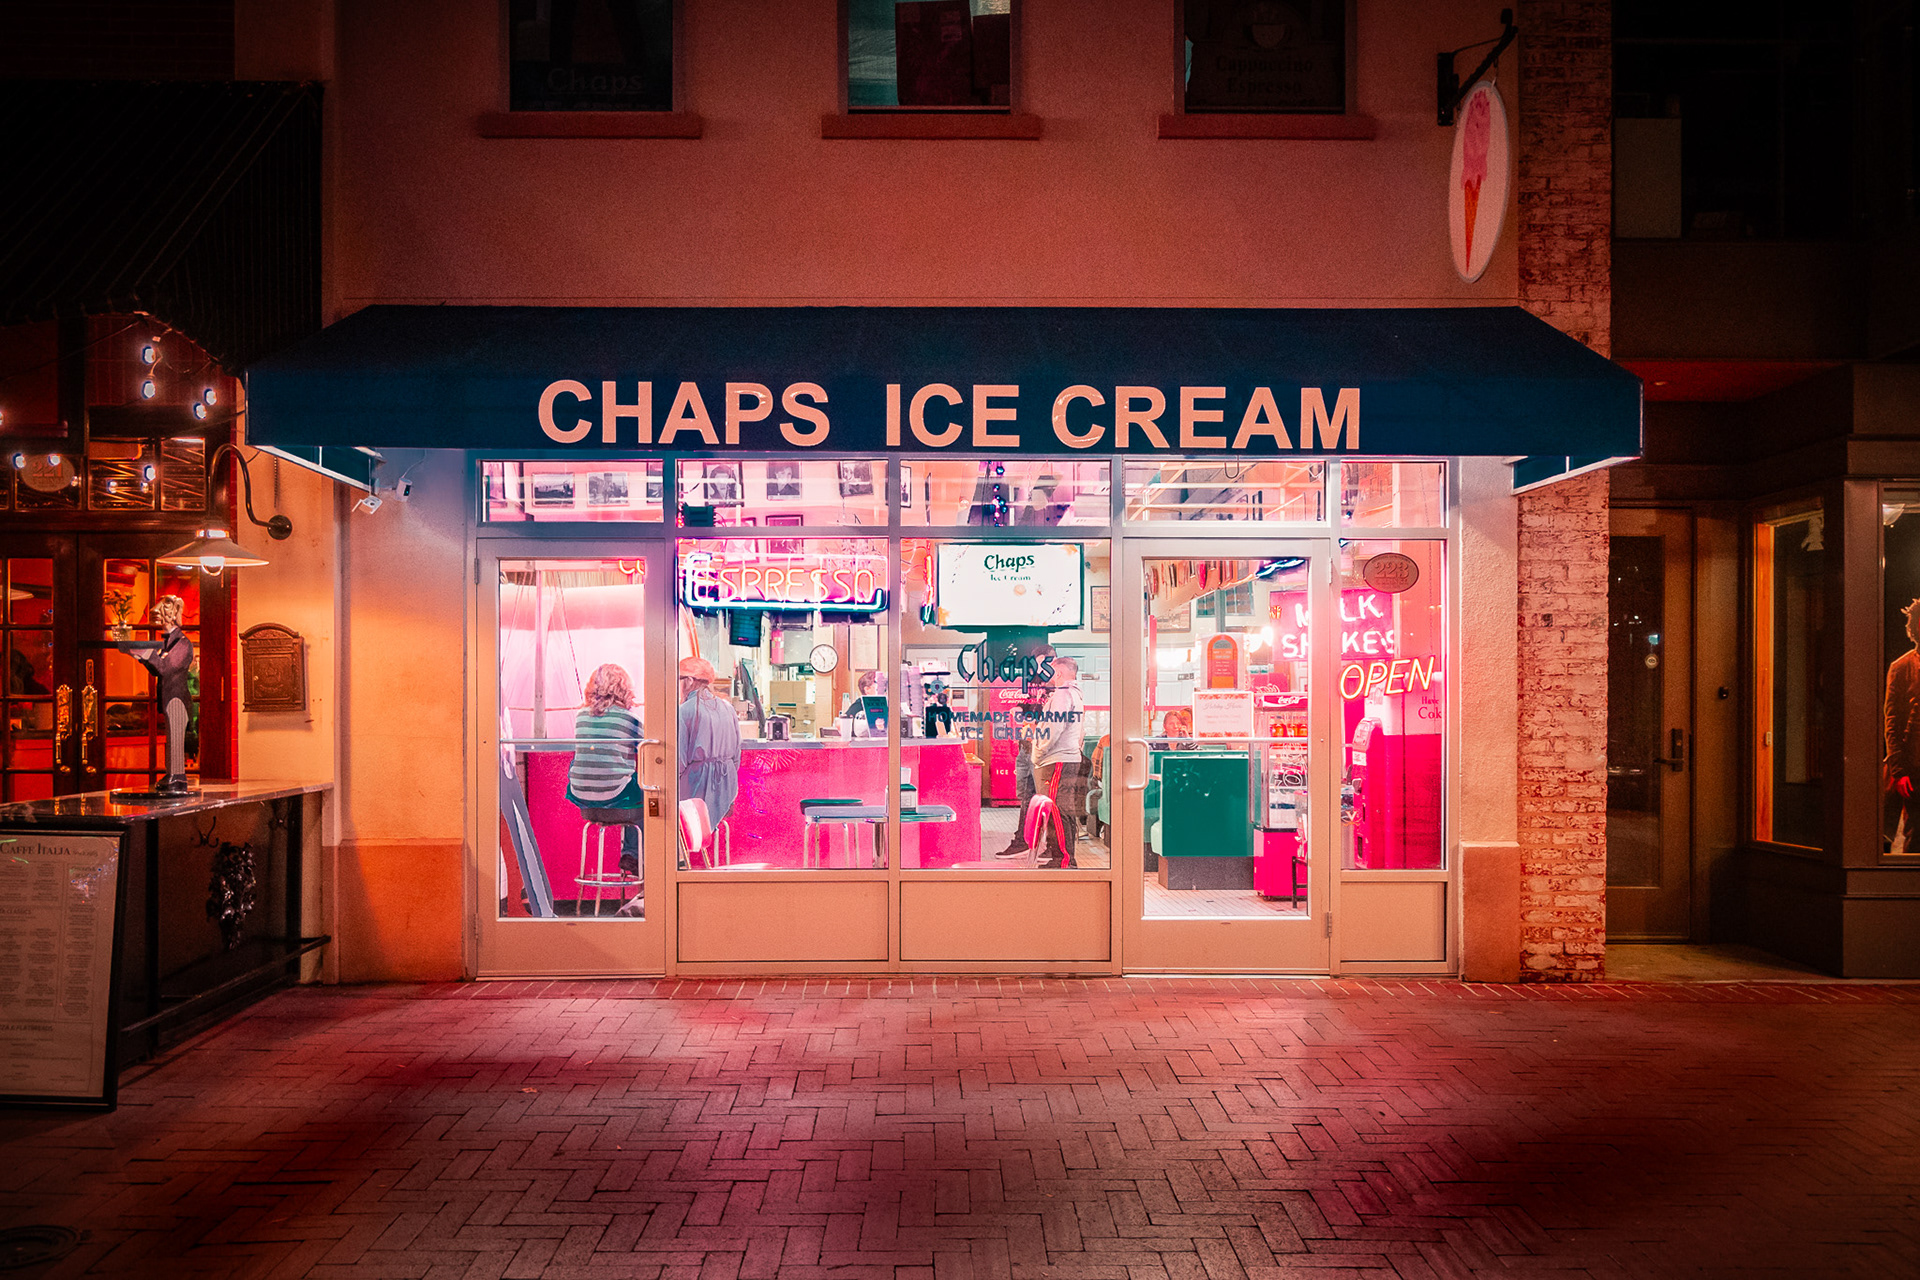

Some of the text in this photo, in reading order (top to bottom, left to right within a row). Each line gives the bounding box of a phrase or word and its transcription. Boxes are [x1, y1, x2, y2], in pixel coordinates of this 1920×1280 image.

[1216, 56, 1313, 74] Cappuccino
[547, 68, 642, 96] Chaps
[1227, 78, 1302, 95] Espresso
[538, 380, 1360, 451] CHAPS ICE CREAM
[984, 554, 1035, 573] Chaps
[1374, 562, 1409, 579] 223
[1295, 594, 1384, 628] MLK
[956, 638, 1056, 694] Chaps
[1340, 656, 1436, 699] OPEN
[1421, 696, 1439, 705] Have
[928, 711, 1083, 723] HOMEMADE GOURMET
[1418, 706, 1442, 719] Cok
[960, 727, 1051, 740] ICE CREAM
[37, 843, 71, 856] ITALIA
